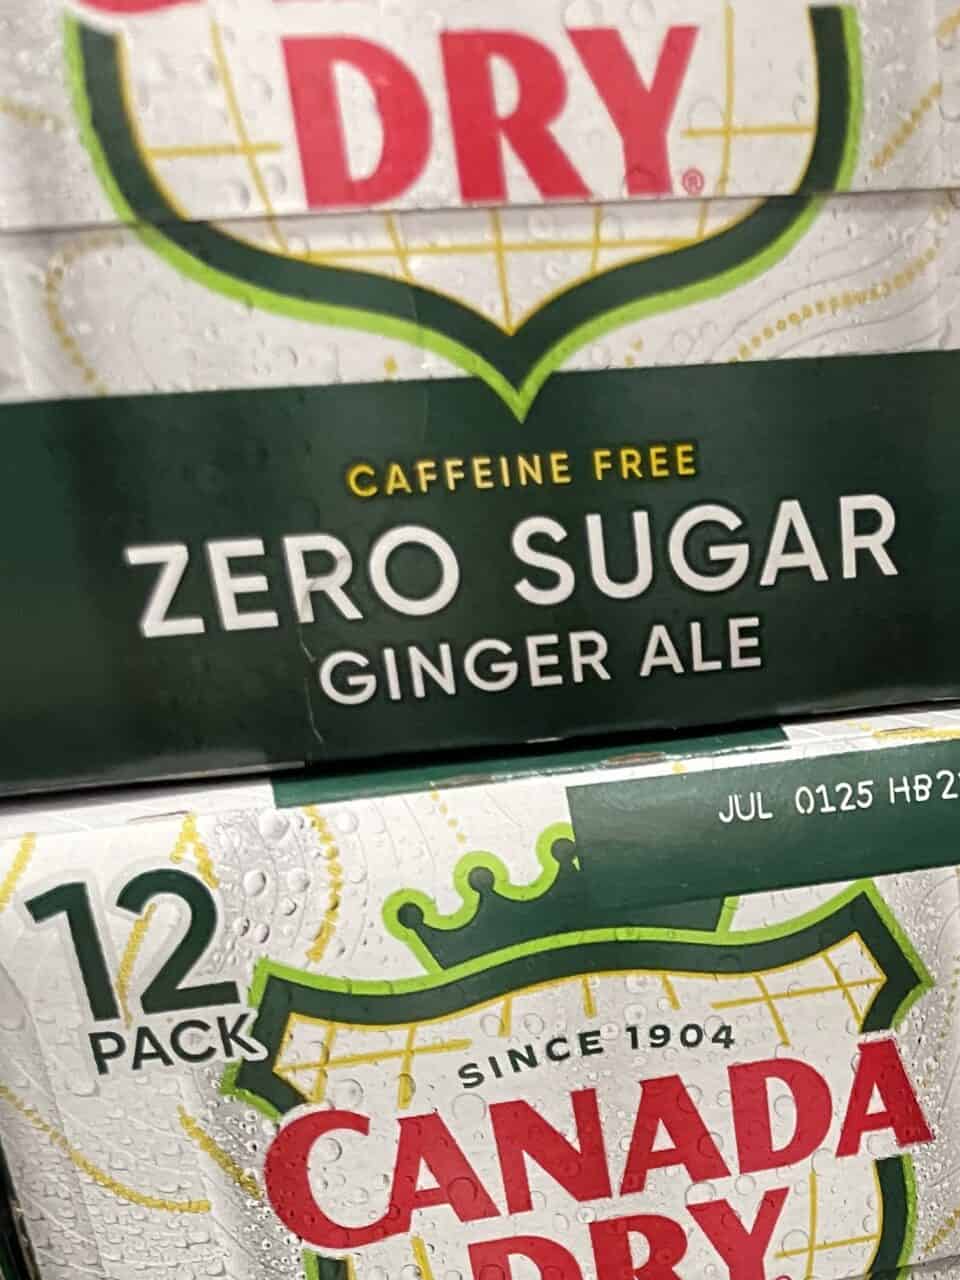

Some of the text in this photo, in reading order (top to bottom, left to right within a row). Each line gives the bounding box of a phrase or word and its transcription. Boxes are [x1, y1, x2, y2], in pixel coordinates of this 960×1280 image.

[281, 26, 700, 211] DRY
[346, 443, 699, 498] CAFFEINE FREE
[124, 493, 899, 640] ZERO SUGAR
[318, 617, 764, 706] GINGER ALE
[718, 791, 773, 823] JUL
[795, 780, 874, 815] 0125
[25, 866, 241, 1024] 12
[88, 1017, 263, 1076] PACK
[456, 1021, 737, 1091] SINCE 1904
[262, 1036, 935, 1250] CANADA
